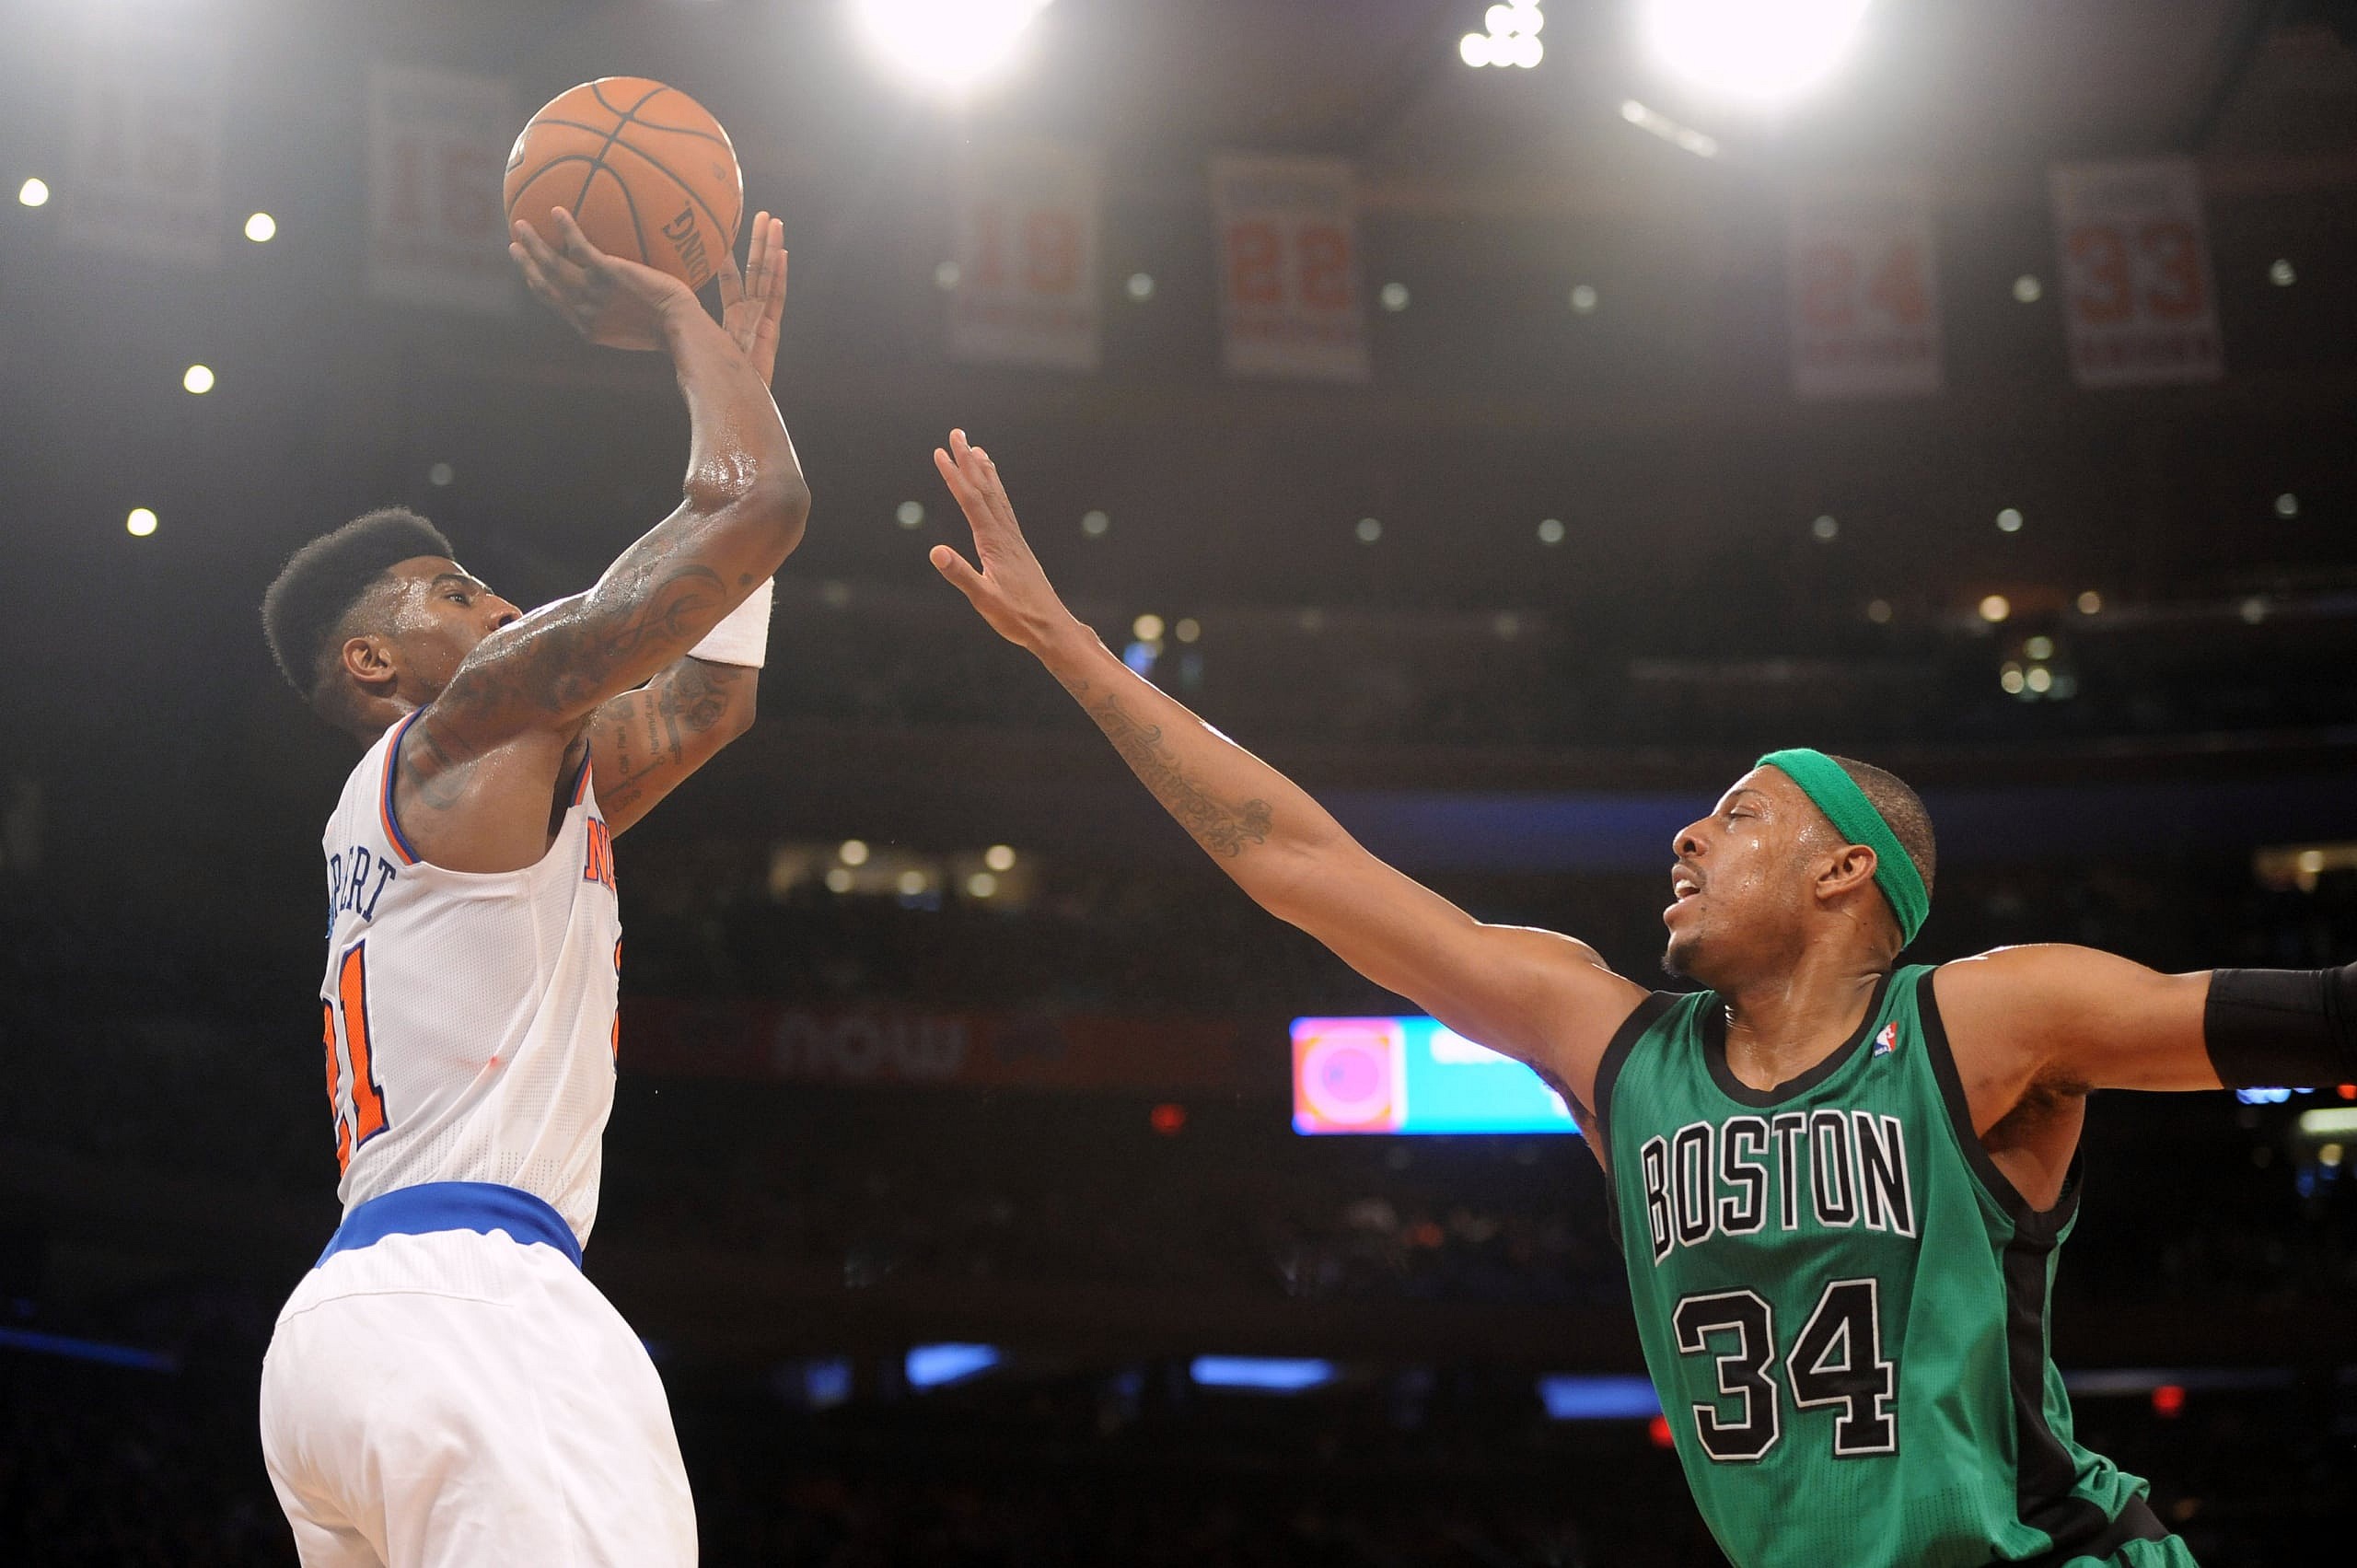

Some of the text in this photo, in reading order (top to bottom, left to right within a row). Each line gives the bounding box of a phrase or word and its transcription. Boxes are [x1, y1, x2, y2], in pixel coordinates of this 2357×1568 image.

[2068, 221, 2205, 325] 33
[1641, 1109, 1916, 1267] BOSTON
[1670, 1276, 1899, 1462] 34
